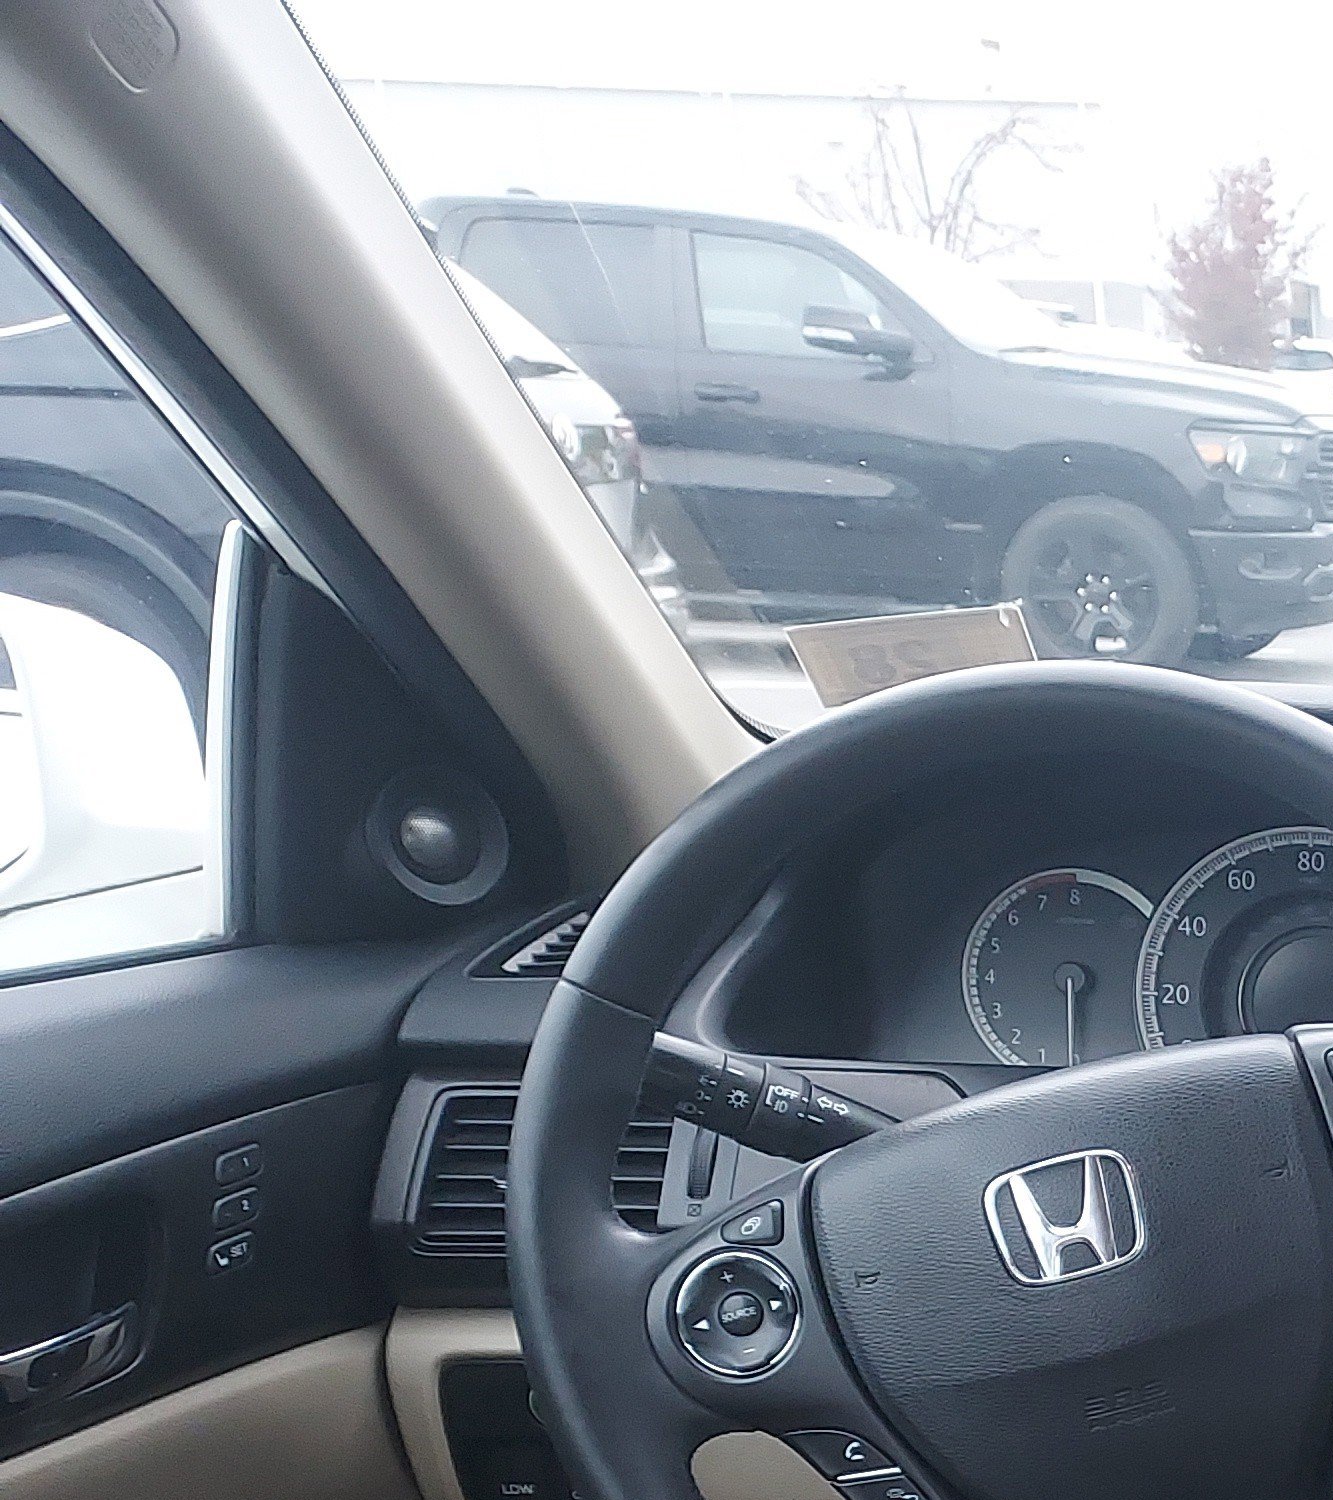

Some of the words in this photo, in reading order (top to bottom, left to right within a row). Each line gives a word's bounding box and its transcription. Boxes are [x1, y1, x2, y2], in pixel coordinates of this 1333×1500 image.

[1298, 852, 1325, 871] 80
[1227, 870, 1255, 891] 60
[1037, 895, 1048, 911] 7
[1069, 889, 1081, 905] 8
[1008, 909, 1019, 926] 6
[1177, 916, 1207, 937] 40
[990, 937, 1000, 954] 5
[984, 968, 995, 984] 4
[1162, 984, 1190, 1004] 20
[992, 1001, 1002, 1019] 3
[1011, 1028, 1021, 1045] 2
[1038, 1048, 1046, 1063] 1
[774, 1085, 800, 1100] OFF
[721, 1306, 757, 1323] SOURCE
